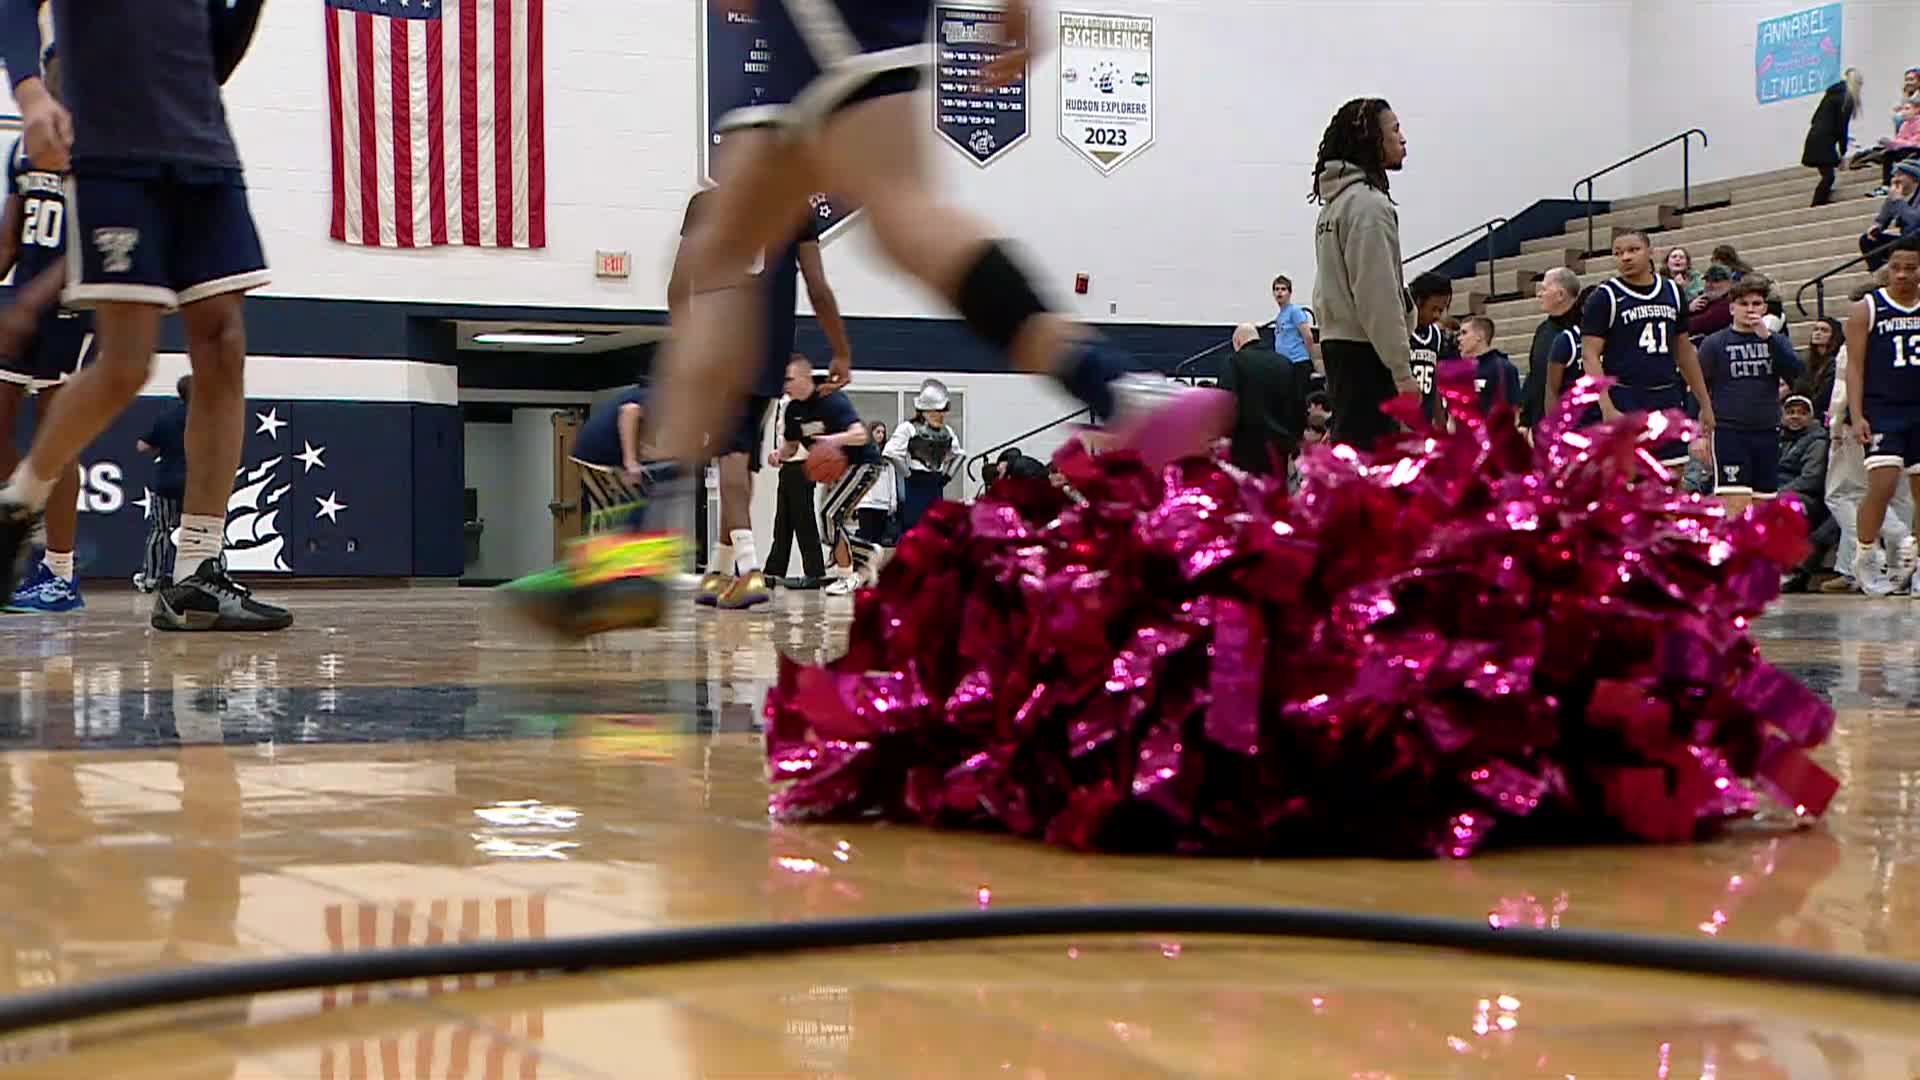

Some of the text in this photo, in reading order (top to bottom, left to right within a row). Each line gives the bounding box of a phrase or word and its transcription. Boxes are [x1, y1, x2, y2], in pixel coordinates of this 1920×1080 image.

[1064, 27, 1150, 50] EXCELLENCE
[1762, 10, 1828, 45] ANNABEL
[1762, 70, 1824, 99] LINDLEY
[1065, 99, 1147, 114] HUDSON EXPLORERS
[1084, 127, 1127, 146] 2023
[22, 198, 63, 247] 20
[1638, 321, 1669, 353] 41
[1892, 335, 1920, 367] 13
[1413, 365, 1434, 394] 35
[1730, 359, 1773, 378] CITY
